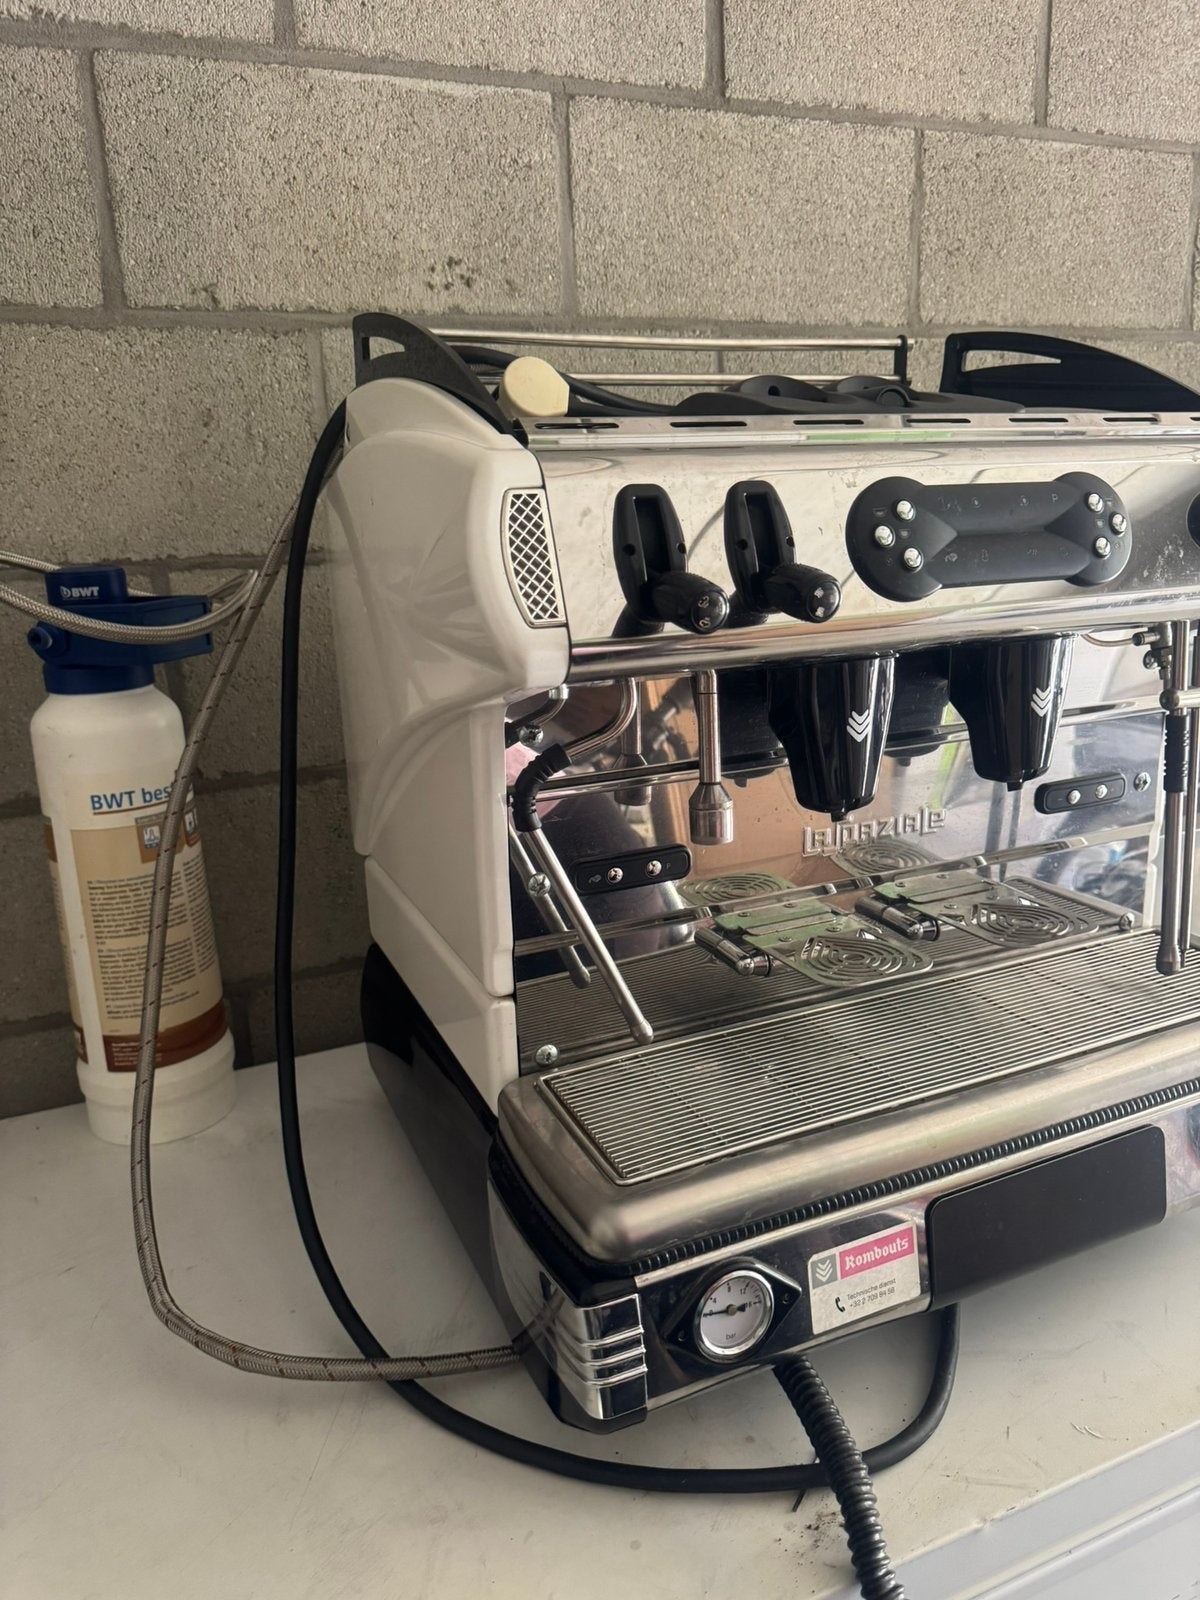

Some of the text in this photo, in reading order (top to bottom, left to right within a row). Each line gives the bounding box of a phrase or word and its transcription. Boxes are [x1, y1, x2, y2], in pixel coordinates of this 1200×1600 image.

[71, 586, 99, 598] BWT
[90, 786, 172, 811] BWT bes
[844, 1237, 909, 1271] Rombouts
[847, 1284, 878, 1301] Technische
